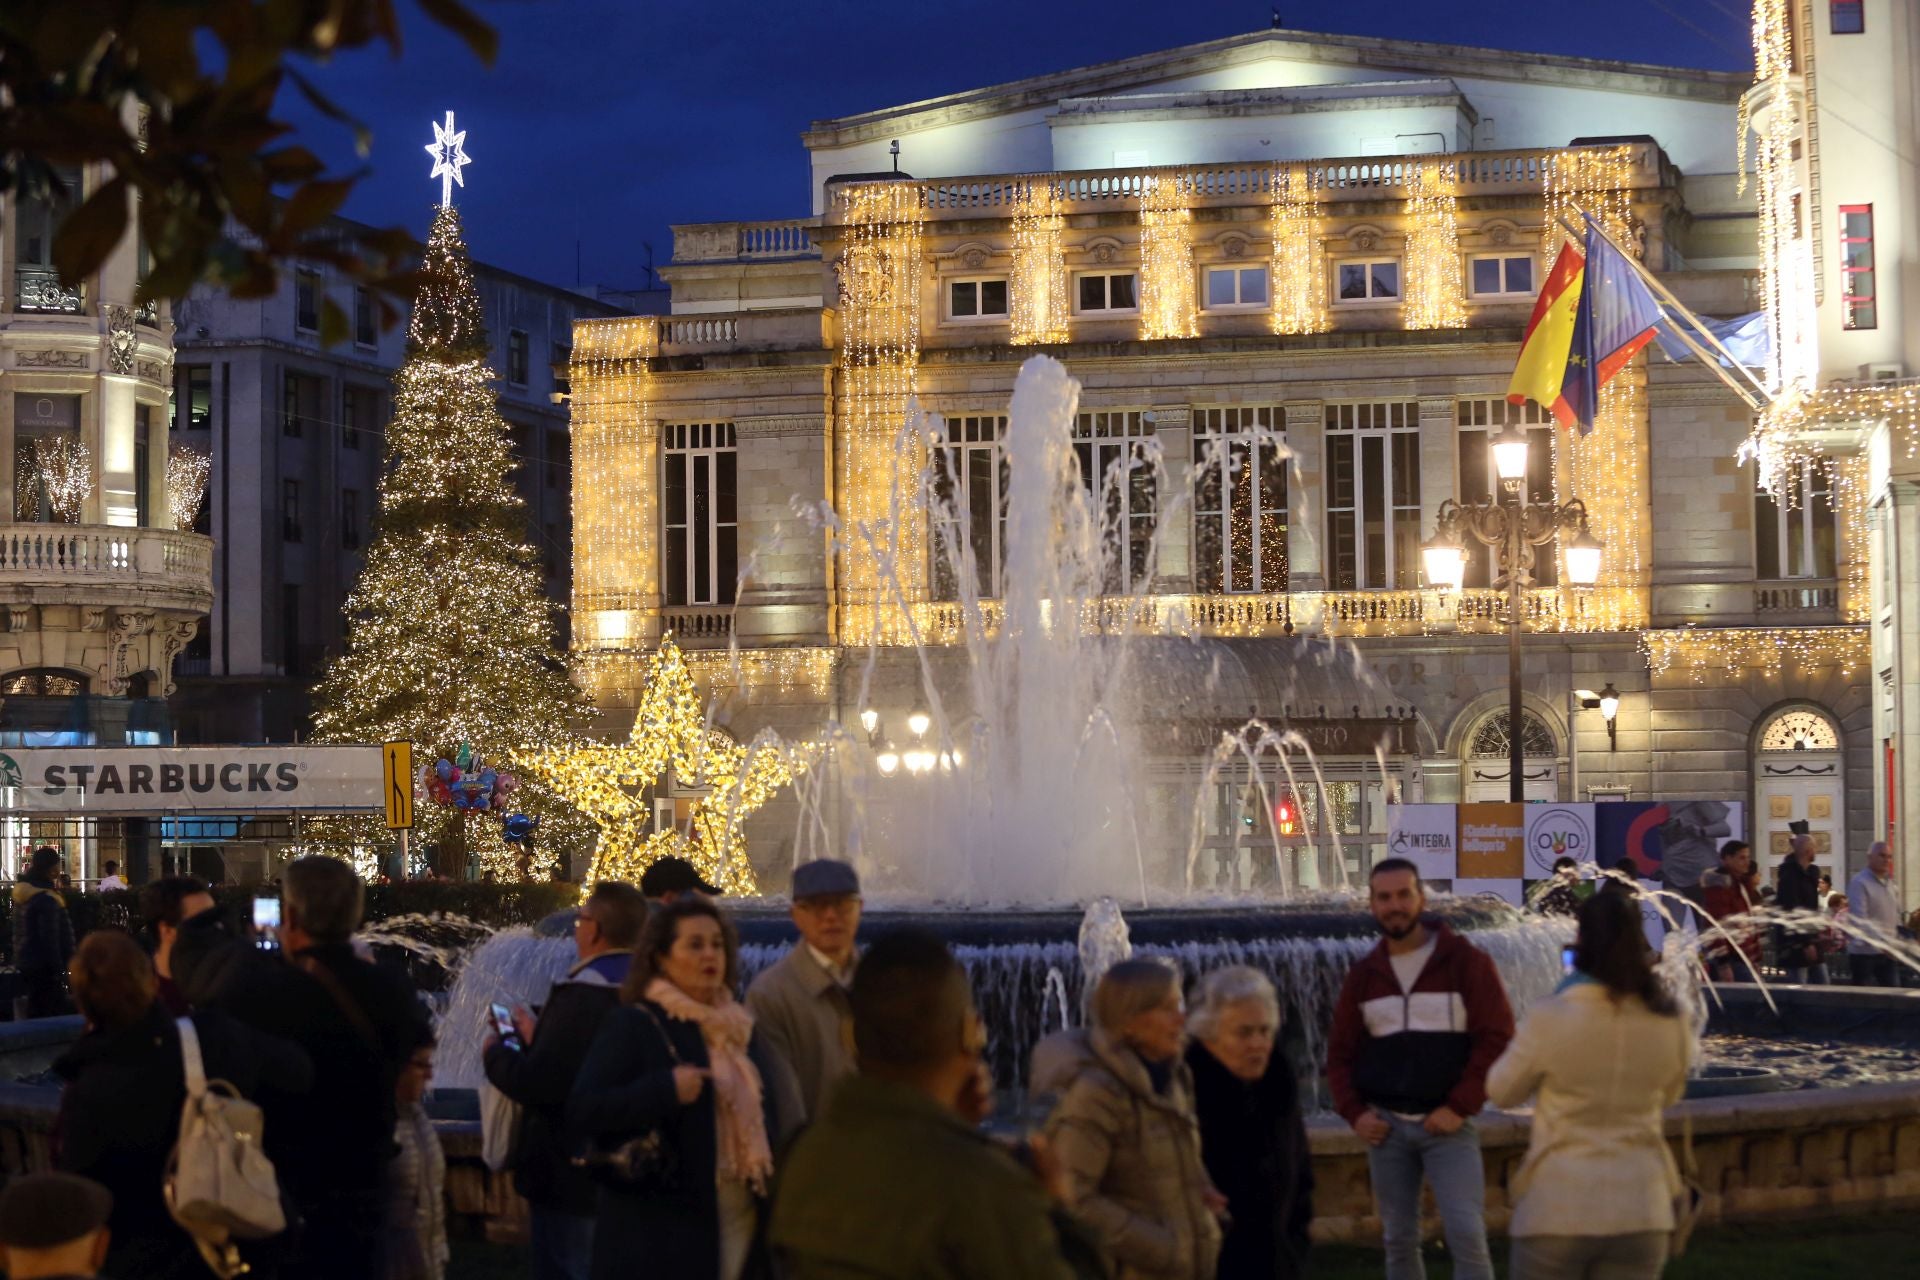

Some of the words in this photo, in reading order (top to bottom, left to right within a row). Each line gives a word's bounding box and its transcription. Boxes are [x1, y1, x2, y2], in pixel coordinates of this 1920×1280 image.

[43, 762, 299, 796] STARBUCKS
[1410, 833, 1451, 848] INTEGRA
[1538, 831, 1580, 850] OVD
